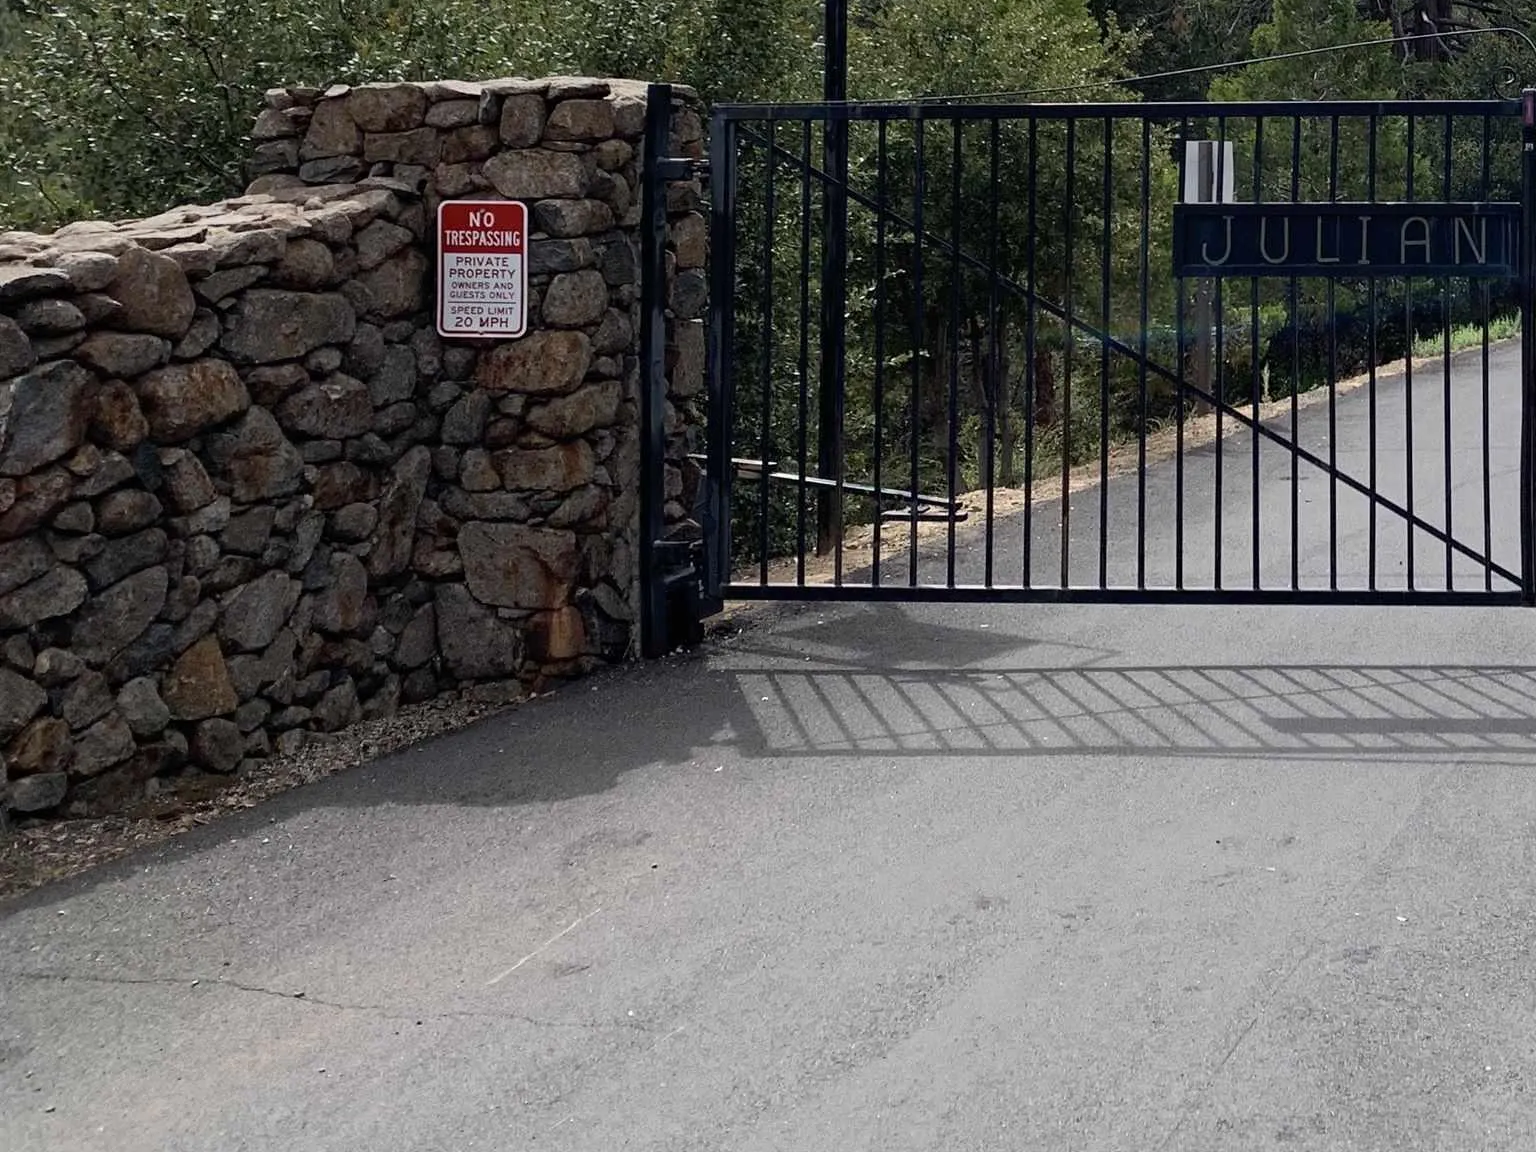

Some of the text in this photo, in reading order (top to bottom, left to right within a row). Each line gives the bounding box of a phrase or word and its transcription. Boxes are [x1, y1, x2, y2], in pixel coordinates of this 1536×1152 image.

[469, 212, 494, 227] NO
[444, 231, 520, 246] TRESPASSING
[1201, 215, 1487, 265] JULIAN
[456, 257, 509, 267] PRIVATE
[449, 269, 516, 278] PROPERTY
[489, 292, 514, 300] ONLY
[451, 306, 514, 315] SPEED LIMIT
[455, 317, 509, 328] 20 MPH
